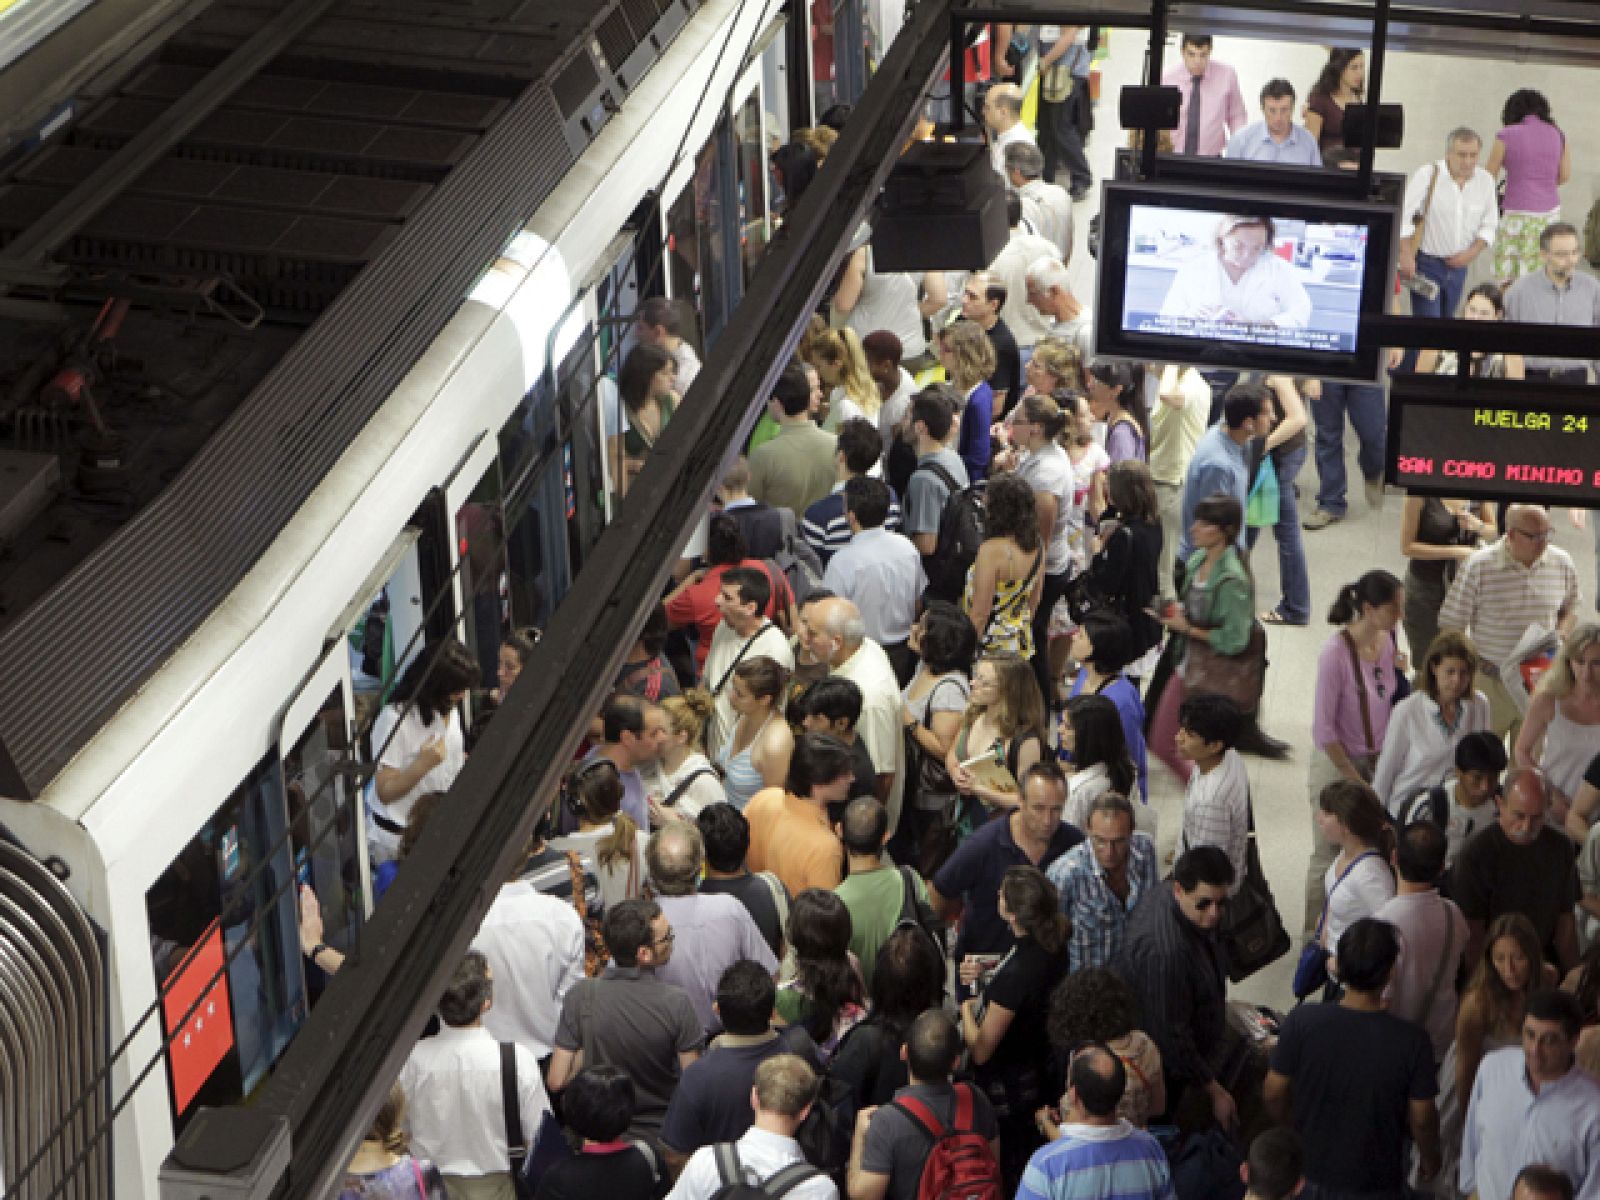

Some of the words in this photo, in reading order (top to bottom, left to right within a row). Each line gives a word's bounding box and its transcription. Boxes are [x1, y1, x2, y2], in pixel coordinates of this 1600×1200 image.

[1473, 409, 1551, 431] HUELGA
[1561, 414, 1589, 433] 24
[1442, 460, 1496, 480] COMO
[1504, 465, 1584, 486] MINIMO
